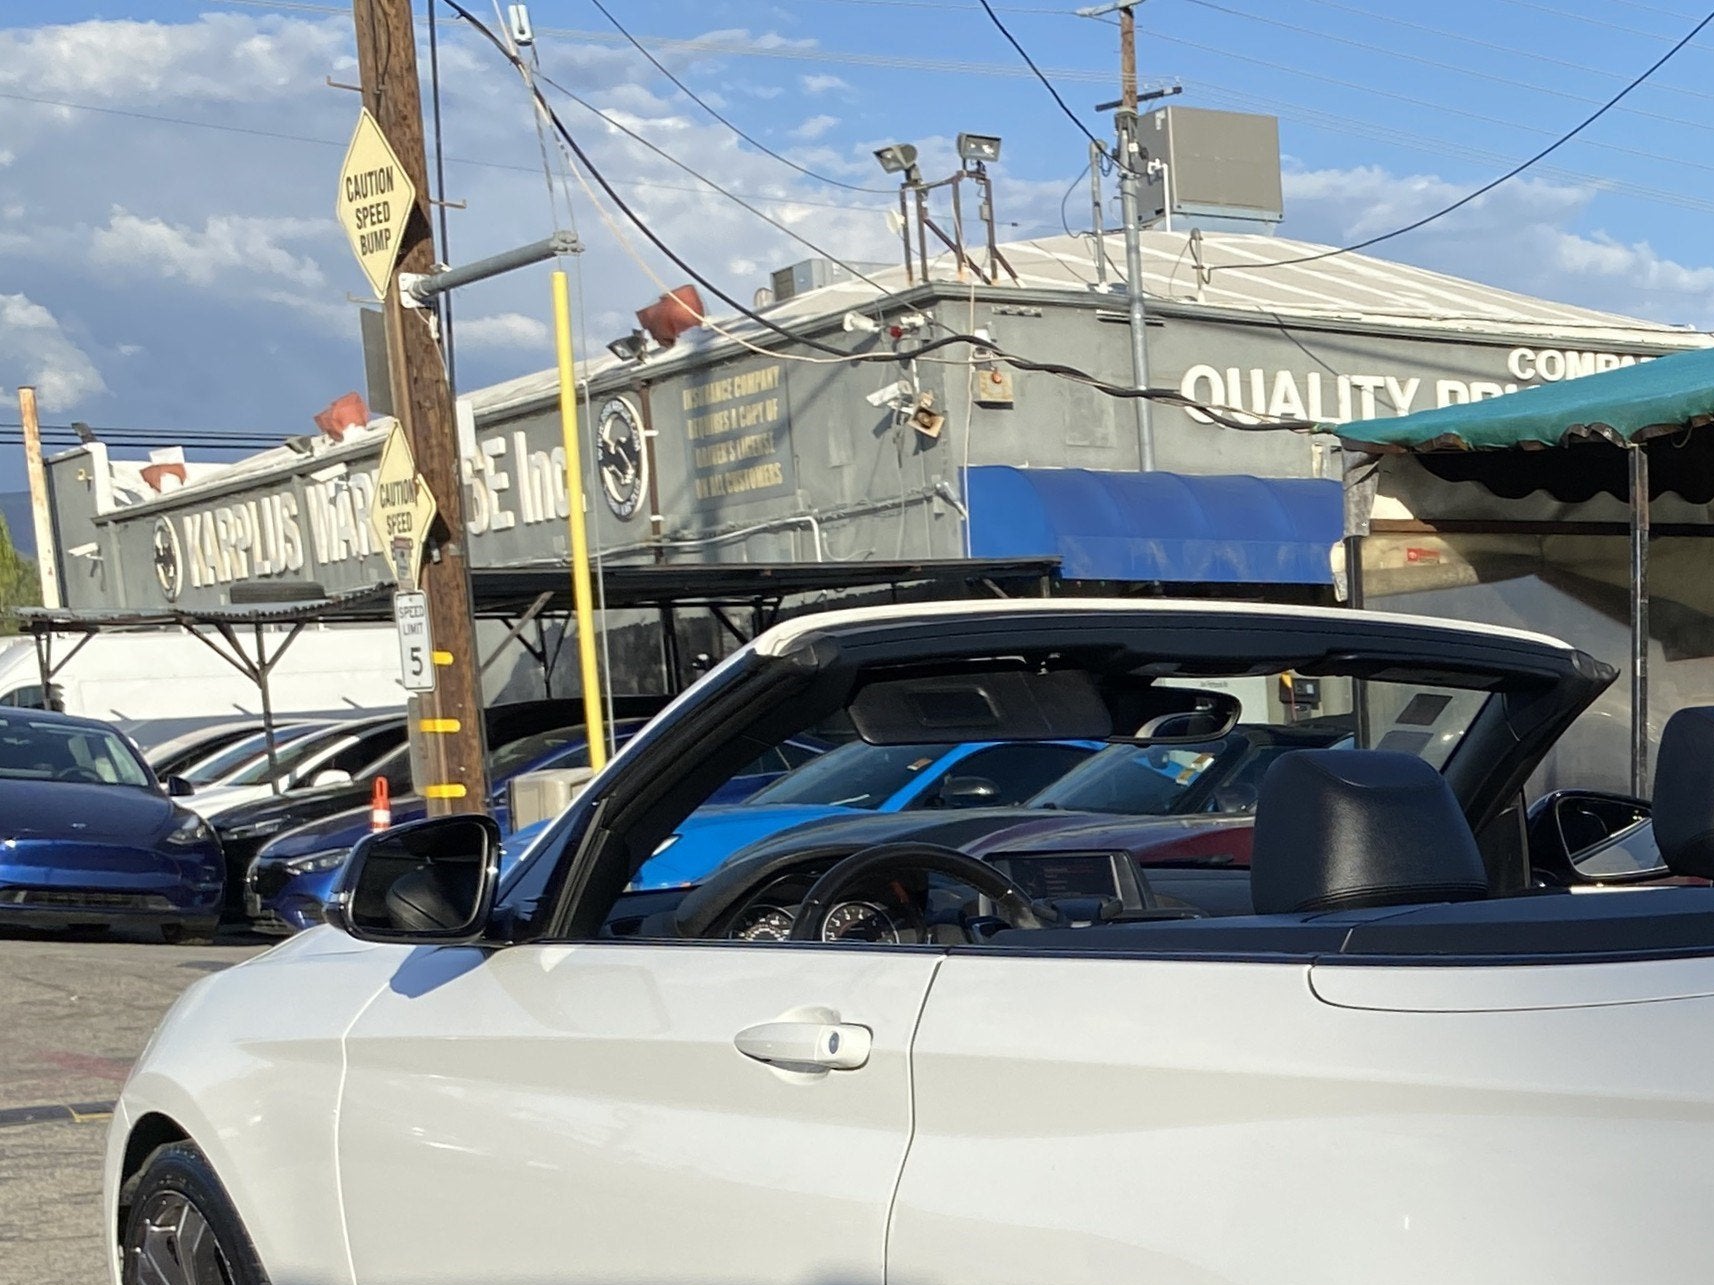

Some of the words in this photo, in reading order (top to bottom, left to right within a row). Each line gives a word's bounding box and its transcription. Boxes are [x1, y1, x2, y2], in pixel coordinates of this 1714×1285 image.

[345, 165, 394, 203] CAUTION
[355, 200, 391, 230] SPEED
[360, 228, 392, 257] BUMP
[1181, 364, 1421, 425] QUALITY
[380, 478, 417, 508] CAUTION
[386, 511, 413, 536] SPEED
[182, 491, 304, 588] KARPLUS
[398, 604, 425, 619] SPEED
[402, 622, 424, 636] LIMIT
[410, 647, 424, 677] 5
